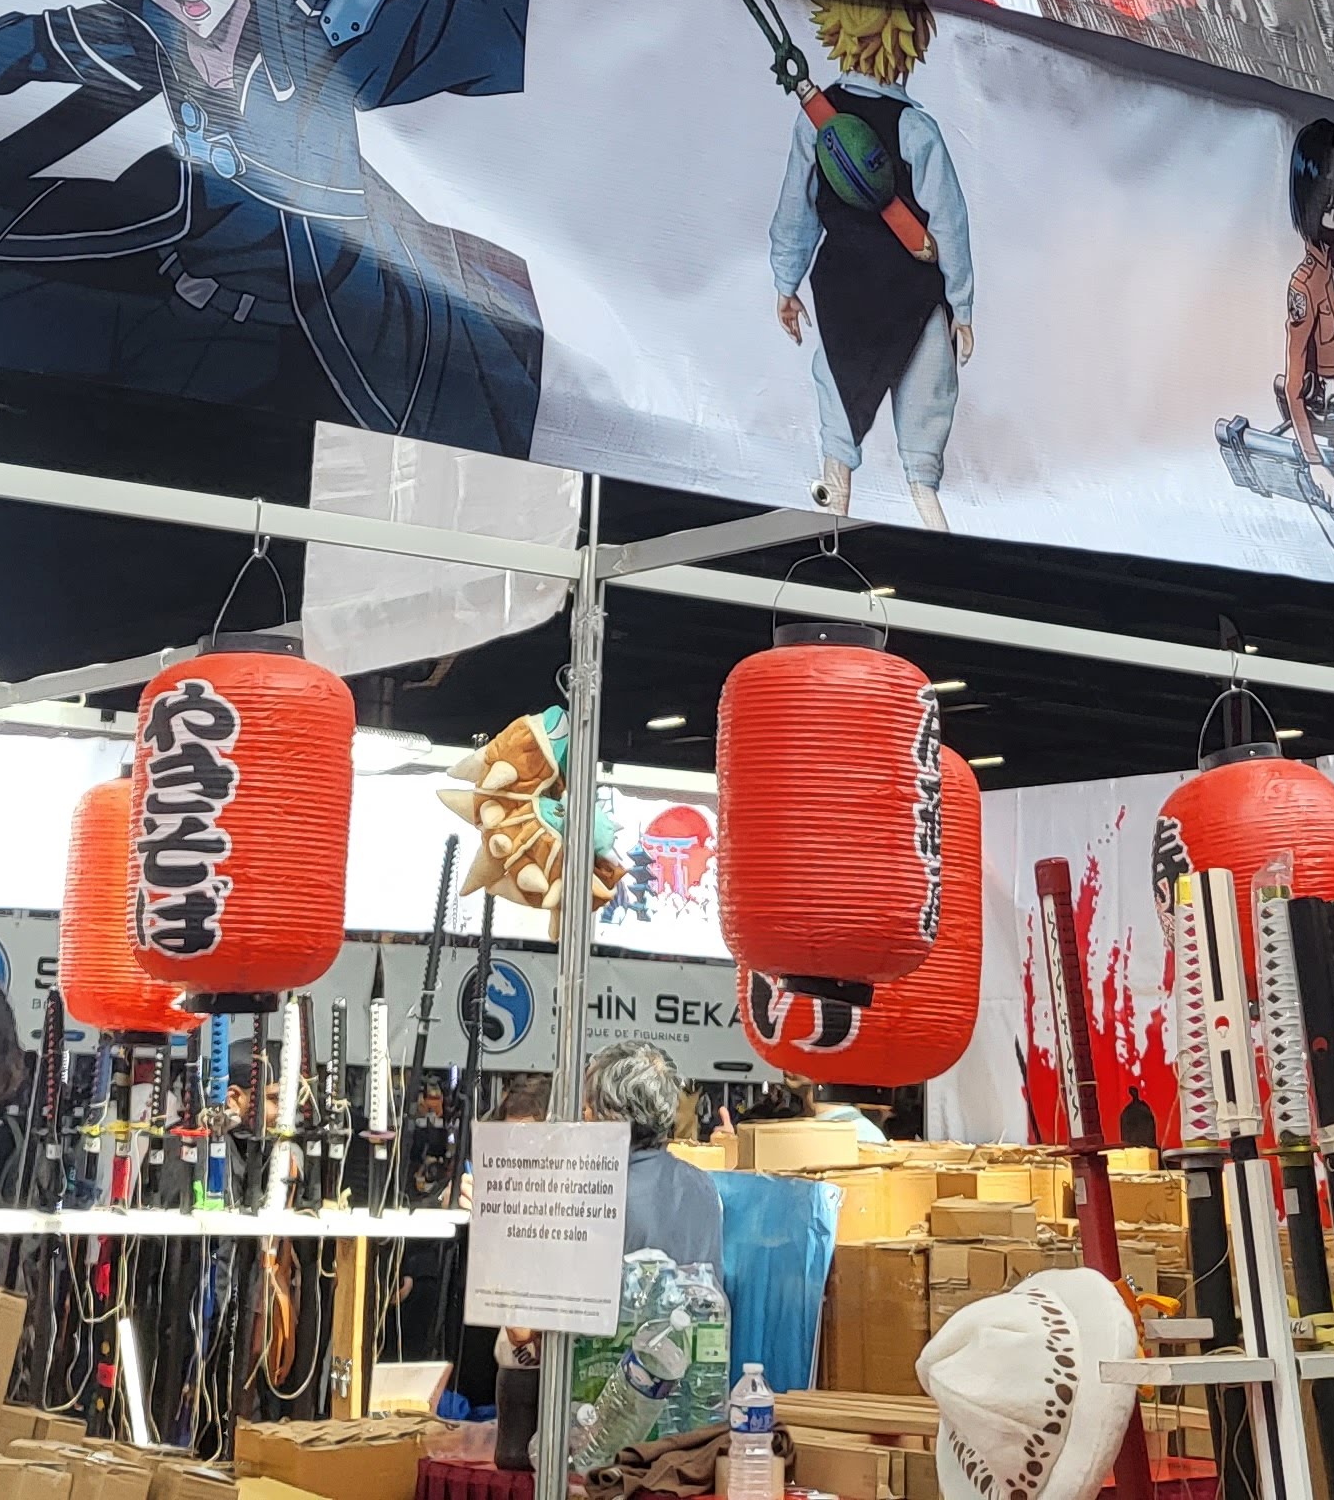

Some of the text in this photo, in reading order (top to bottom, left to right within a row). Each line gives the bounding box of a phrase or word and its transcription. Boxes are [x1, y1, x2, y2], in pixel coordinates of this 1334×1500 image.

[137, 681, 237, 955] やきそば
[614, 1028, 629, 1038] DE
[633, 1029, 690, 1042] FIGURINES
[483, 1152, 619, 1172] Le consommateur ne bénéficie
[487, 1178, 613, 1194] pas d'un droit de rétractation
[481, 1200, 617, 1219] pour tout achat effectué sur les
[507, 1224, 587, 1242] stands de ce salon
